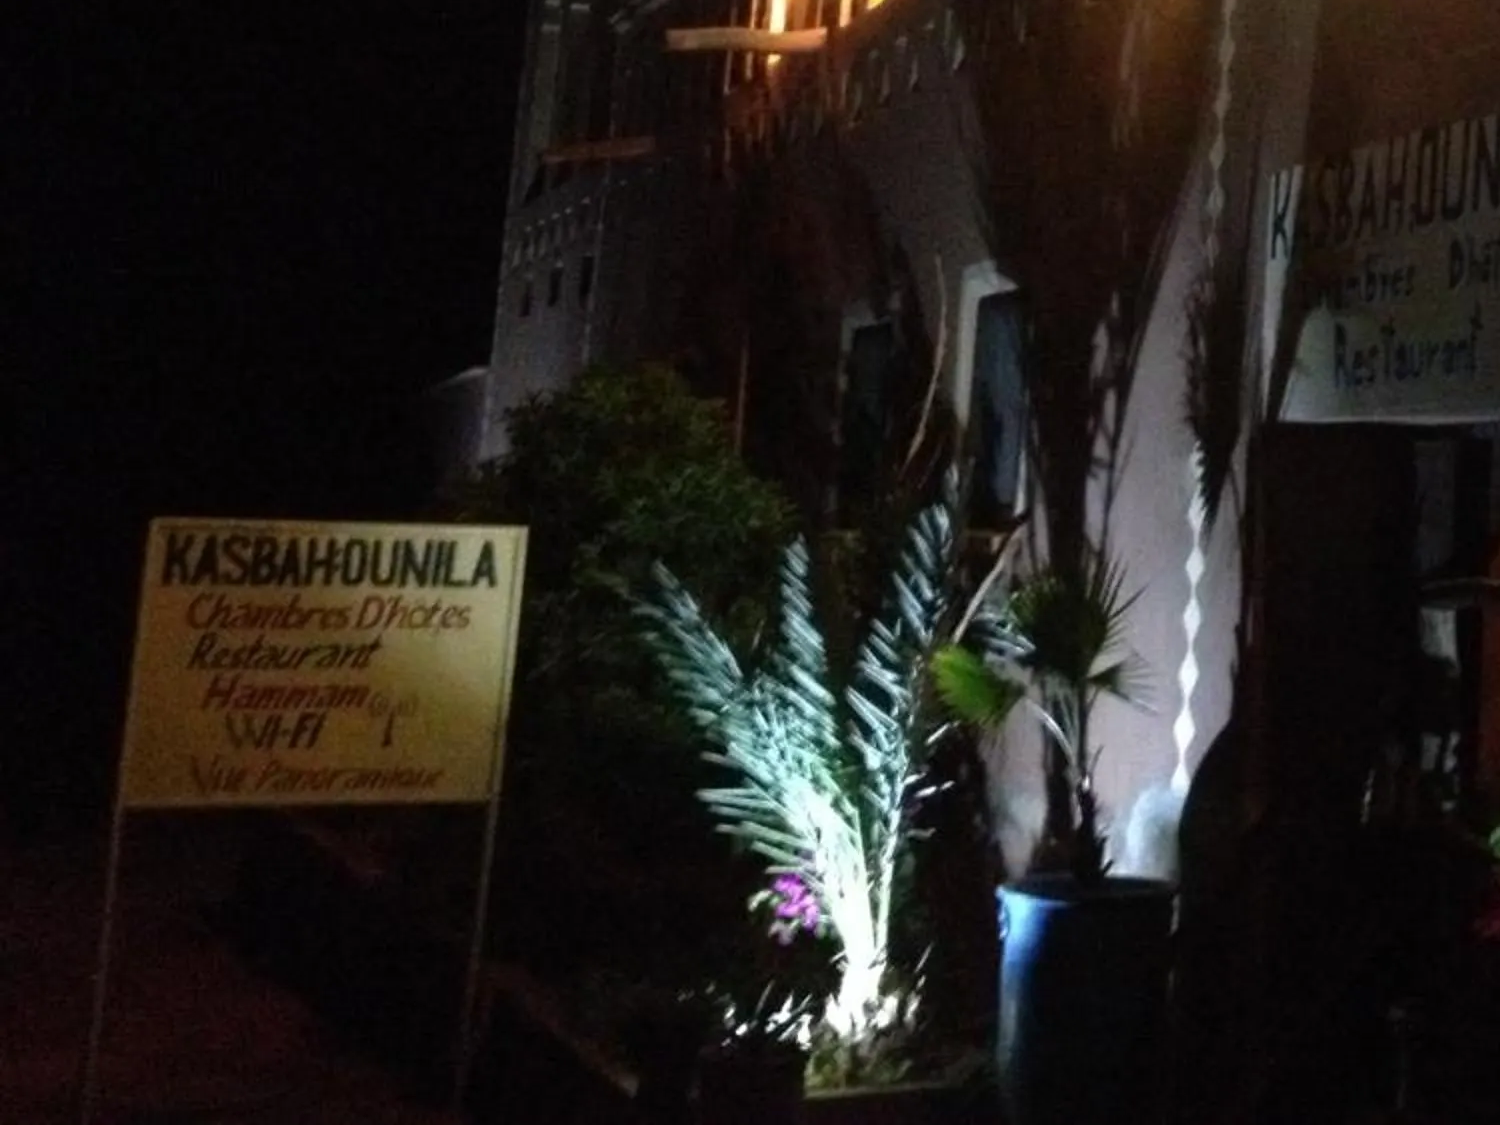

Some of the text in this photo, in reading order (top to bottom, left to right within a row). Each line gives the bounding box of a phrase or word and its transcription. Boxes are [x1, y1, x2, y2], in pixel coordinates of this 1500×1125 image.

[1333, 301, 1485, 389] Restaurant
[185, 592, 353, 631] Chambres
[185, 631, 385, 671] Restaurant
[201, 673, 371, 712] Hammam
